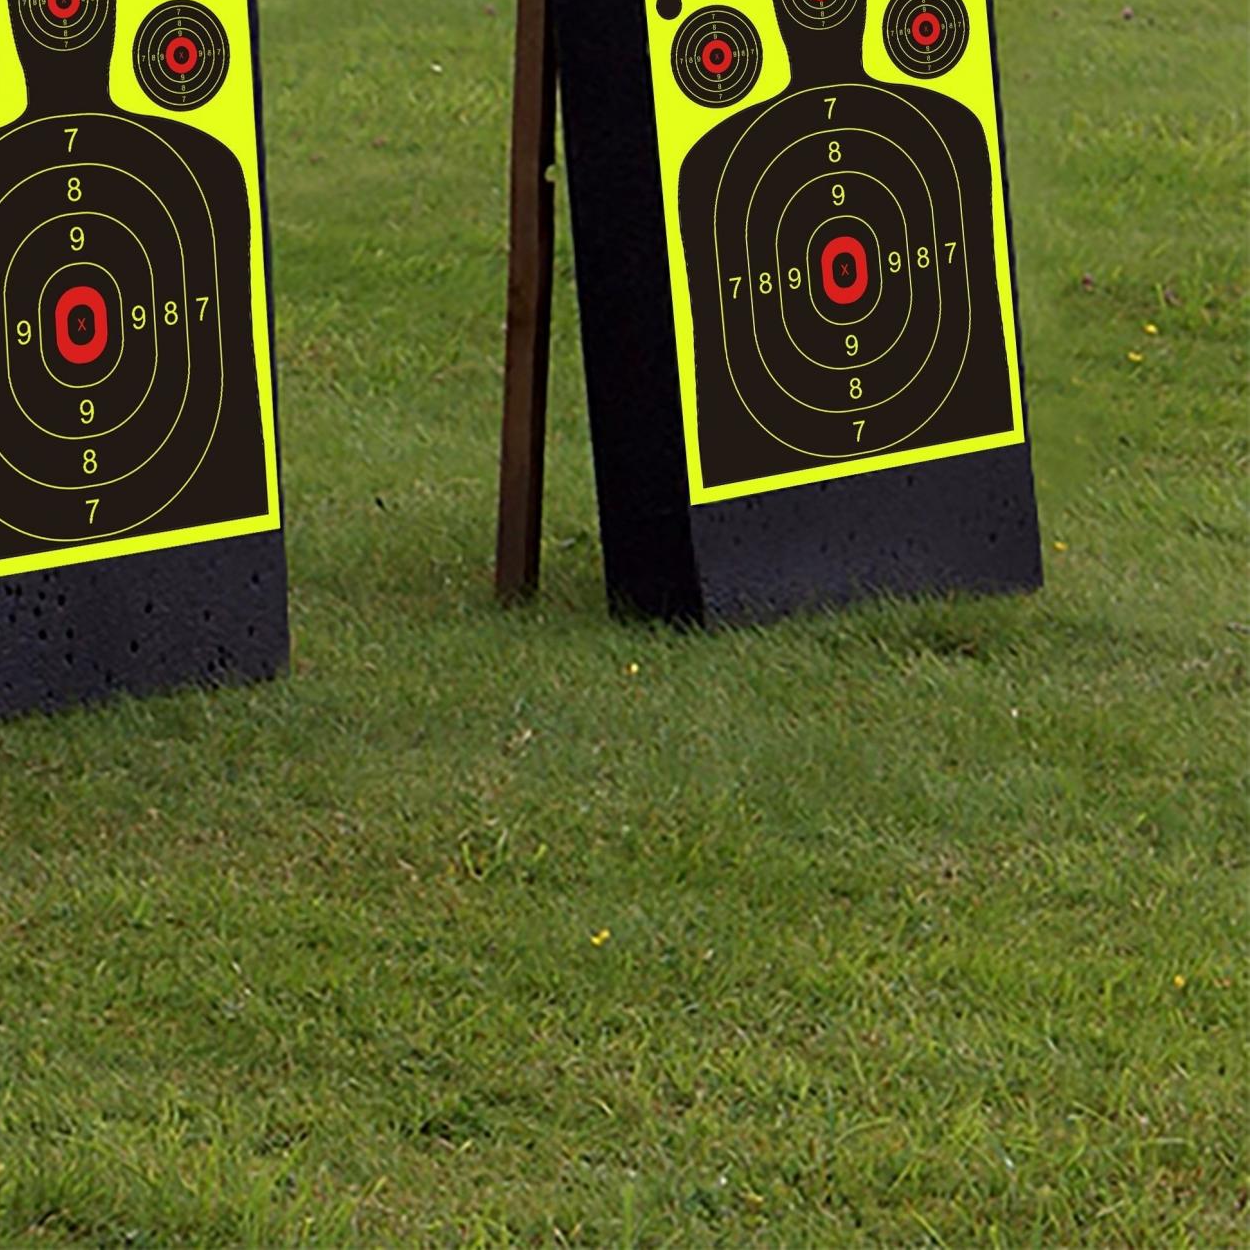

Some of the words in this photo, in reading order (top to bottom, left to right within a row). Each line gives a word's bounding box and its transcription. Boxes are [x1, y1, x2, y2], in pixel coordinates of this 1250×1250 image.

[824, 98, 837, 120] 7
[64, 129, 78, 152] 7
[828, 141, 841, 163] 8
[67, 177, 82, 202] 8
[832, 185, 845, 206] 9
[69, 227, 85, 251] 9
[729, 277, 742, 299] 7
[759, 272, 772, 294] 8
[788, 268, 801, 289] 9
[888, 251, 901, 273] 9
[917, 247, 930, 268] 8
[945, 242, 957, 264] 7
[17, 321, 32, 345] 9
[132, 305, 146, 329] 9
[164, 301, 179, 325] 8
[196, 297, 210, 321] 7
[845, 335, 858, 356] 9
[849, 378, 862, 399] 8
[80, 400, 94, 424] 9
[853, 421, 866, 442] 7
[83, 449, 98, 474] 8
[85, 499, 100, 524] 7
